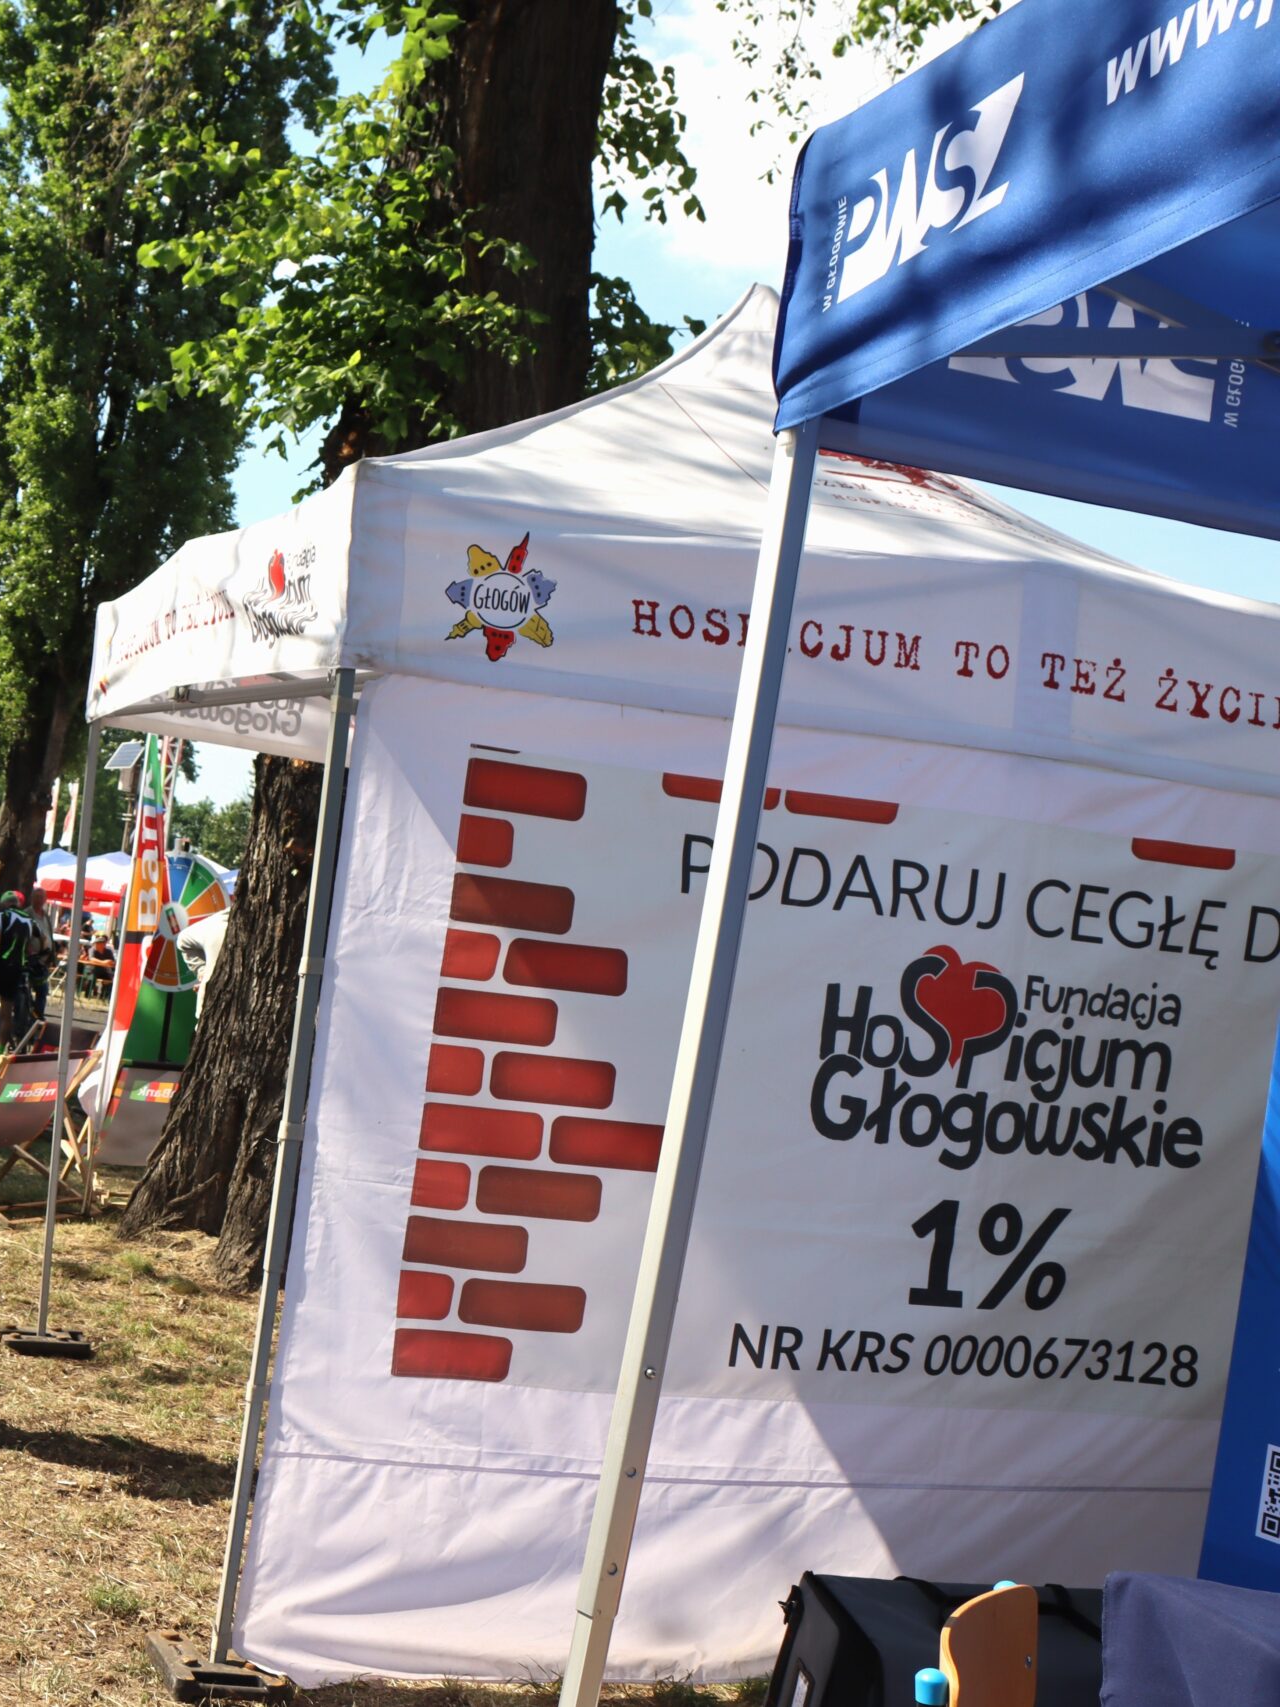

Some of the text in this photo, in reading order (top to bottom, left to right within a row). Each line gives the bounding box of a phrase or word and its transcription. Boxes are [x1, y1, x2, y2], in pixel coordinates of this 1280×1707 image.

[837, 72, 1025, 304] PWSZ
[822, 196, 847, 313] W GŁOGOWIE
[474, 583, 531, 614] GŁOGÓW
[632, 599, 921, 671] HOSCJUM
[955, 642, 1010, 679] TO
[1041, 653, 1126, 702] TEŻ
[1026, 879, 1227, 970] CEGŁĘ
[1024, 975, 1182, 1030] Fundacja
[810, 1055, 1203, 1170] Głogowskie
[909, 1199, 1072, 1311] 1%
[729, 1323, 1199, 1388] NR KRS 0000673128
